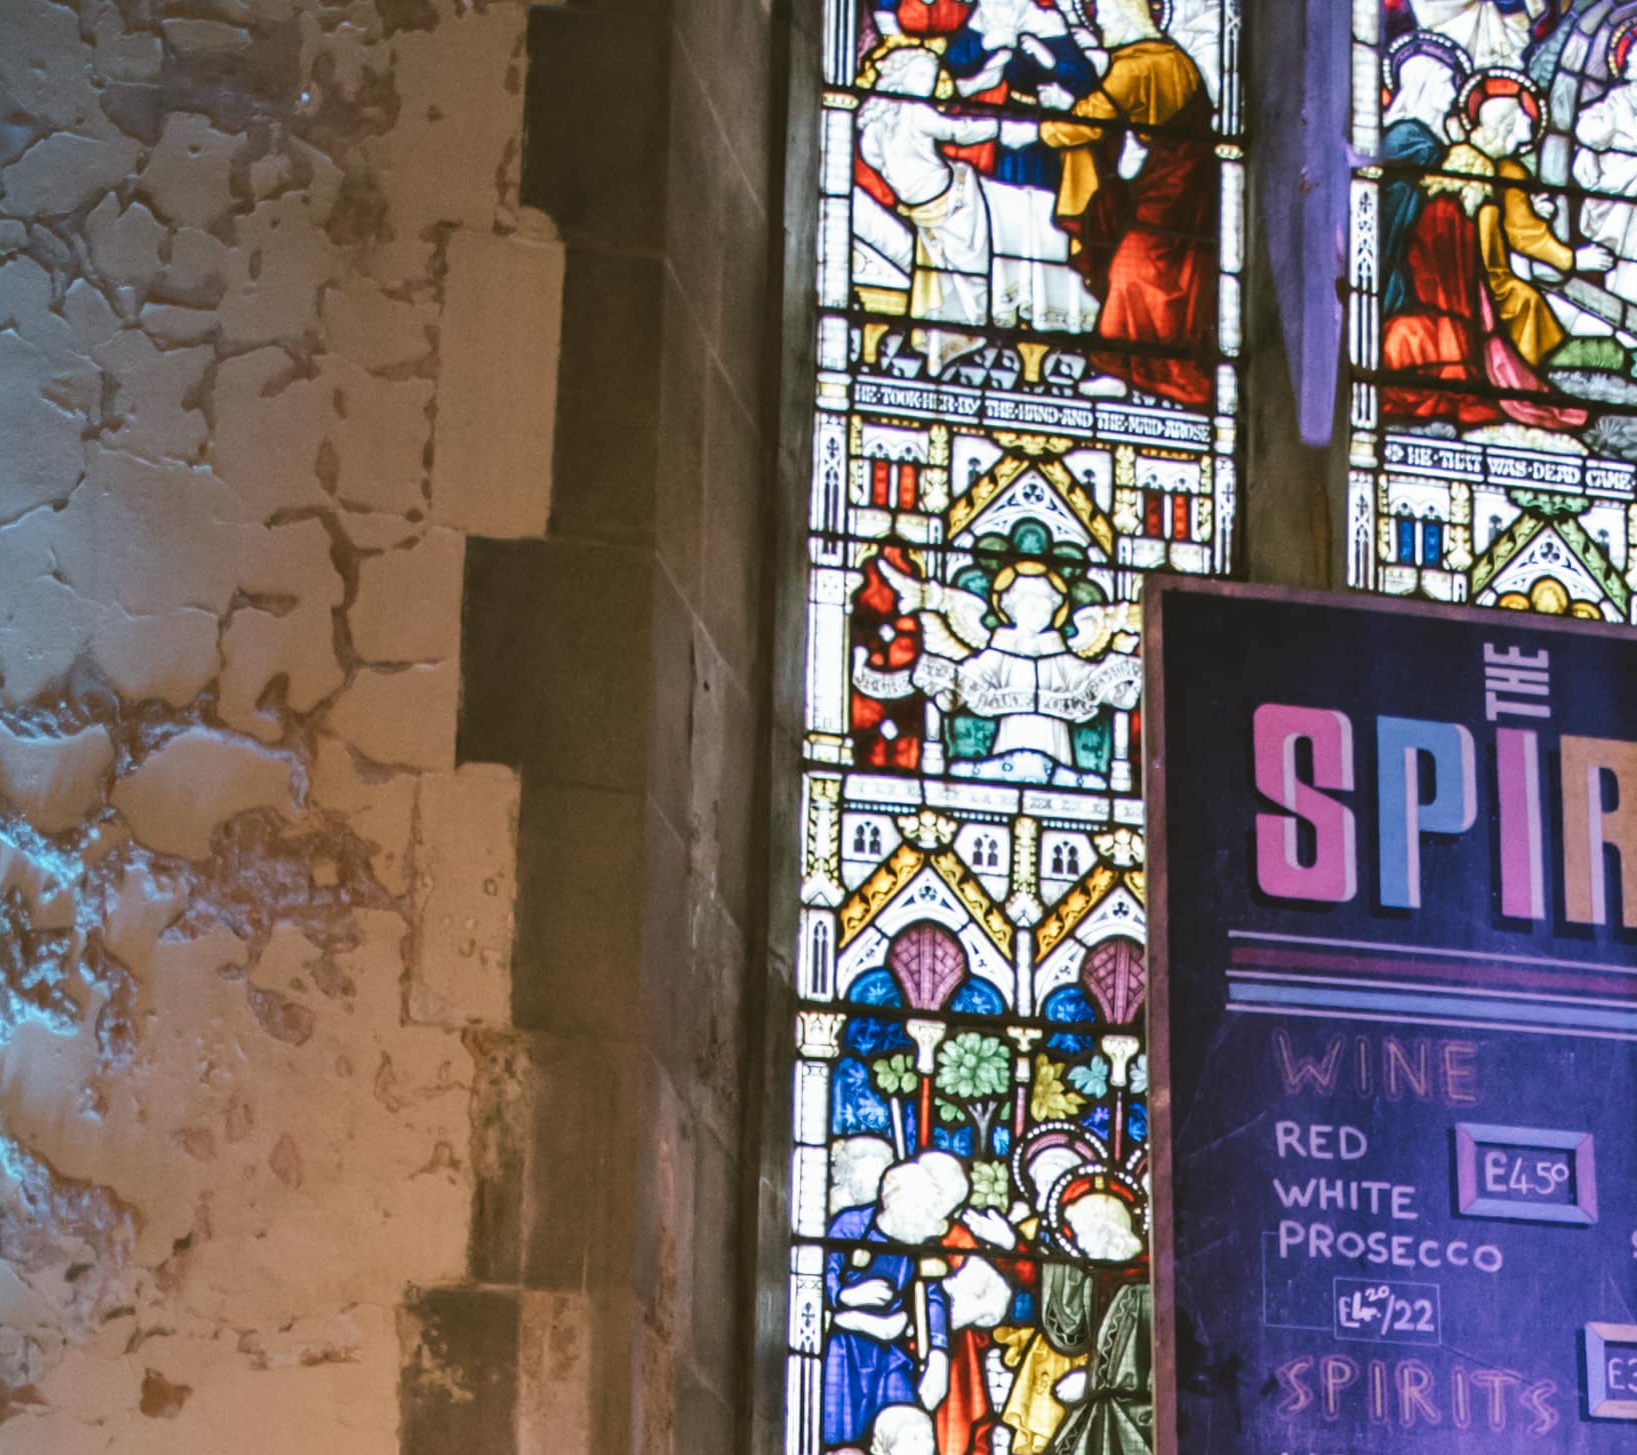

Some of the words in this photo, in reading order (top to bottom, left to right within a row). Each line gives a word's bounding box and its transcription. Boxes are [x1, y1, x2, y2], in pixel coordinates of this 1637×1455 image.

[881, 387, 919, 407] TOOK
[986, 400, 1014, 420] THE
[1018, 403, 1058, 424] HAND
[1061, 407, 1093, 428] AND
[1096, 412, 1124, 432] THE
[1407, 447, 1433, 468] HE
[1439, 450, 1482, 473] THAT
[1487, 457, 1527, 478] WAS
[1532, 461, 1581, 484] DEAD
[1585, 470, 1631, 491] CAME
[1484, 642, 1551, 722] THE
[1272, 1028, 1481, 1107] WINE
[1275, 1120, 1368, 1161] RED
[1272, 1178, 1419, 1220] WHITE
[1278, 1220, 1504, 1273] PROSECCO
[1276, 1354, 1561, 1439] SPIRITS
